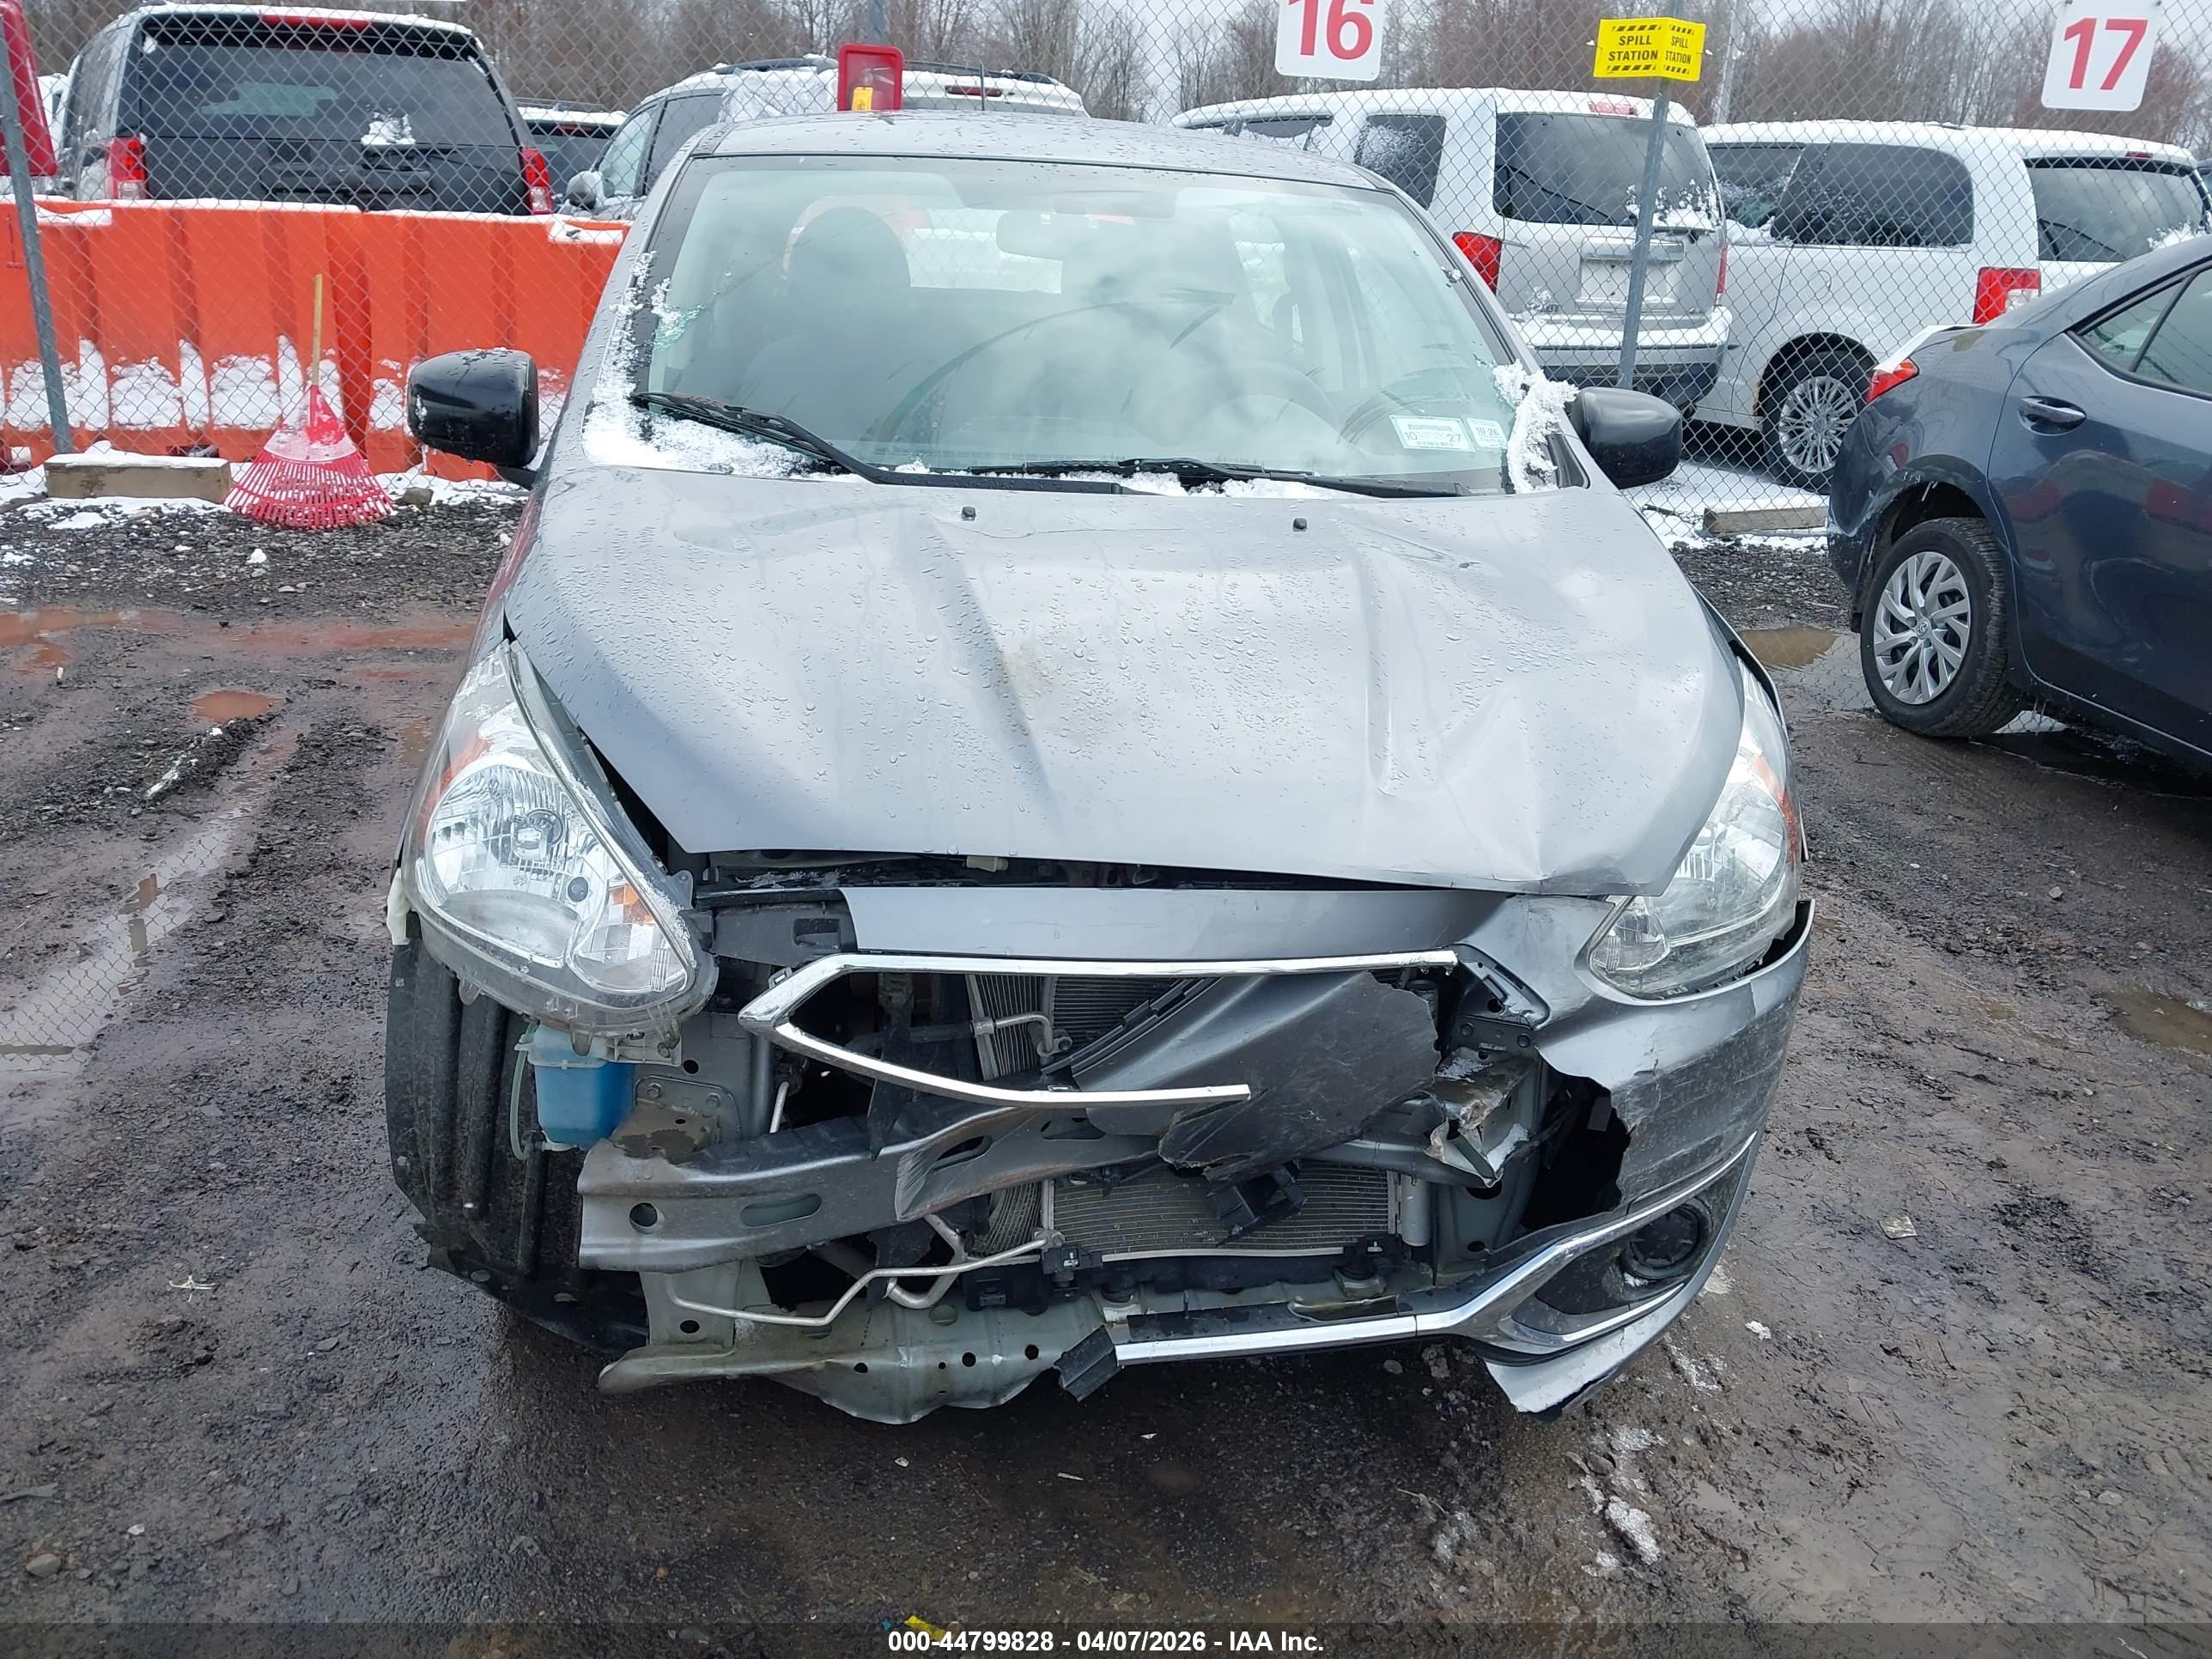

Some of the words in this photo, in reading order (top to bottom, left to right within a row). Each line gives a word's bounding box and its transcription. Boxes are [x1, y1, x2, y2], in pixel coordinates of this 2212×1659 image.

[1288, 0, 1373, 60] 16
[1619, 34, 1652, 46] SPILL
[1671, 35, 1689, 49] SPILL
[1607, 50, 1659, 62] STATION
[1665, 50, 1692, 64] STATION
[2063, 17, 2148, 90] 17
